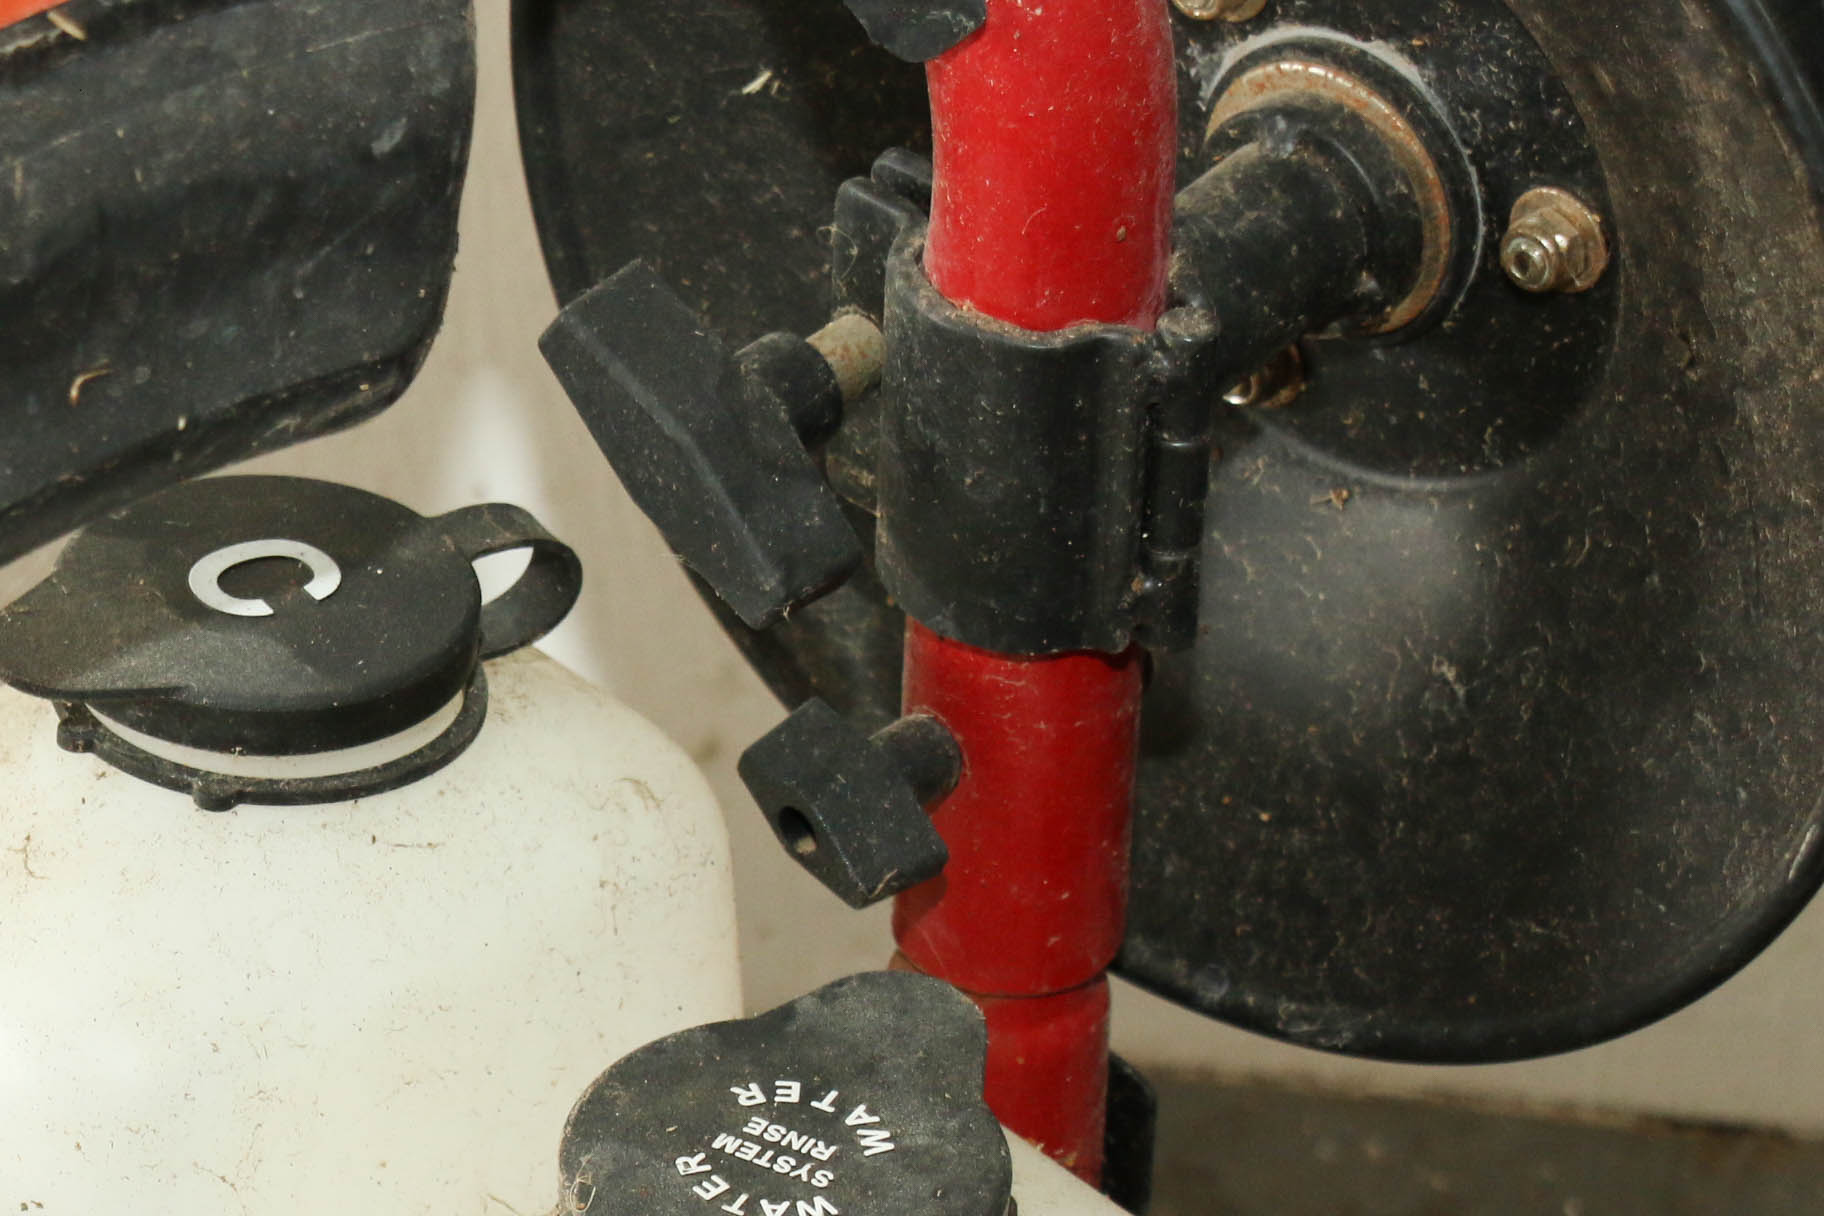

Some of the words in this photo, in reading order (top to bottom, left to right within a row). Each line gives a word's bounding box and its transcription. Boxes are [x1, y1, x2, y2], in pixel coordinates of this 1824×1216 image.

[187, 538, 343, 617] C
[729, 1079, 896, 1157] WATER
[741, 1115, 839, 1161] RINSE
[710, 1132, 836, 1188] SYSTEM
